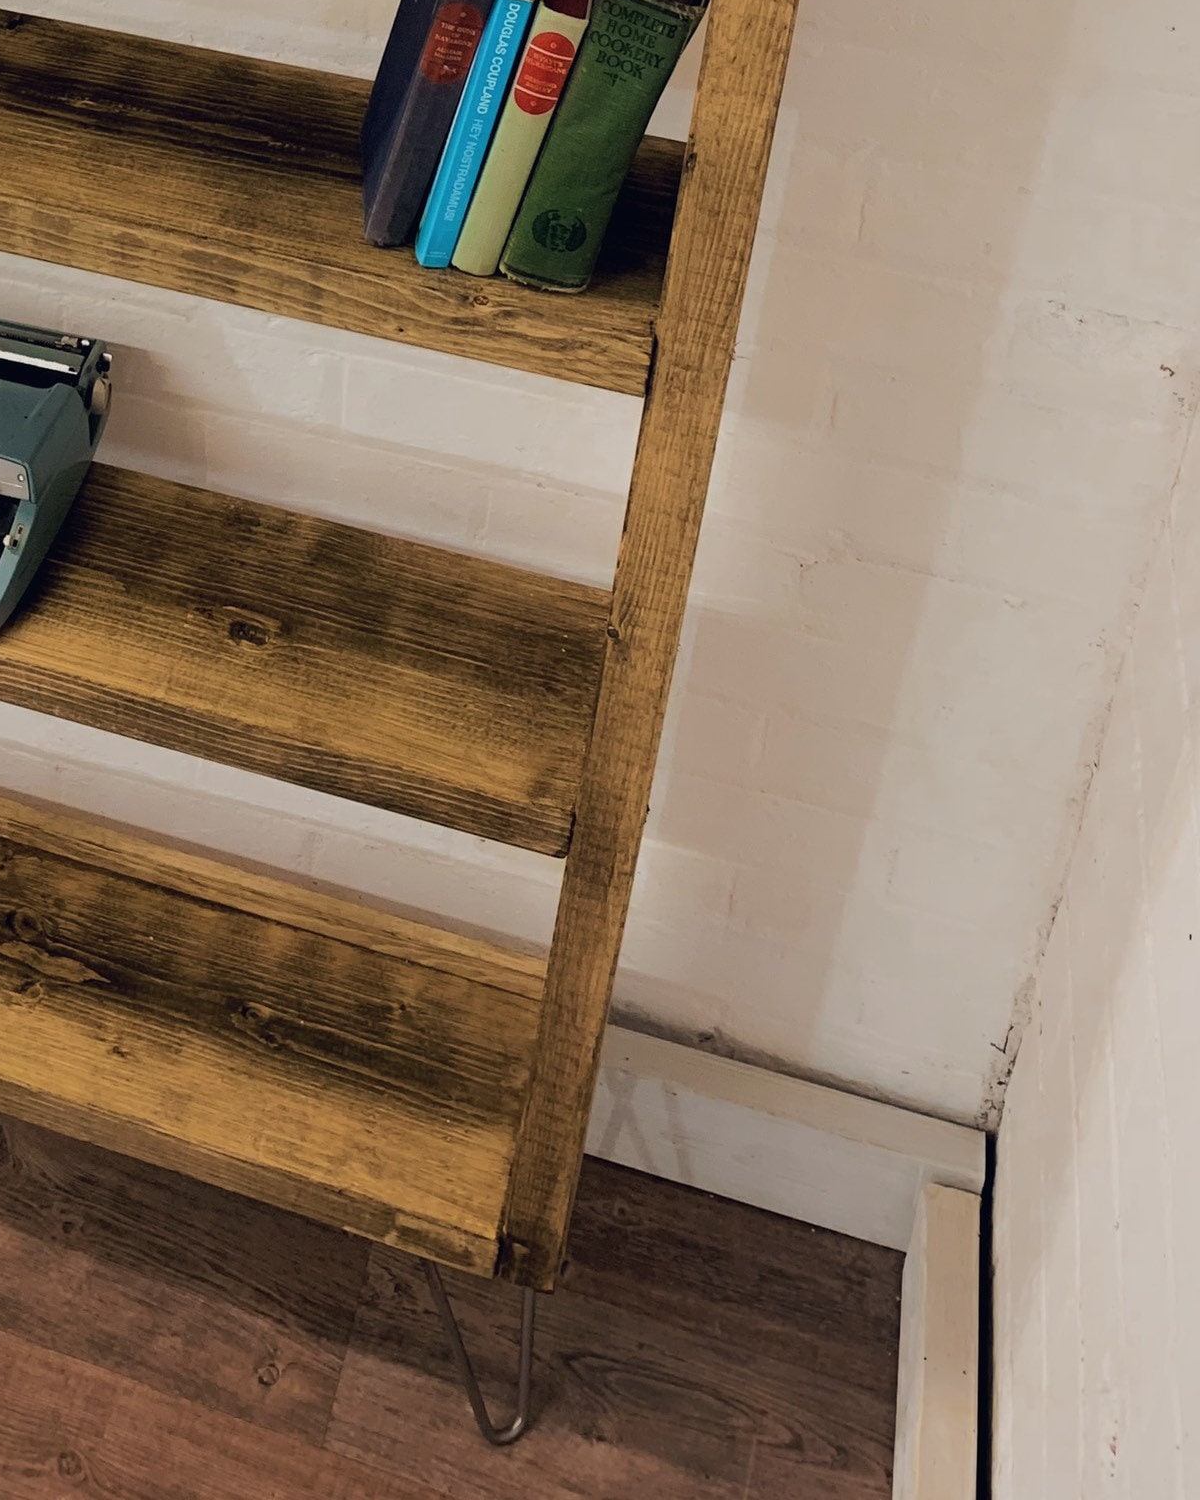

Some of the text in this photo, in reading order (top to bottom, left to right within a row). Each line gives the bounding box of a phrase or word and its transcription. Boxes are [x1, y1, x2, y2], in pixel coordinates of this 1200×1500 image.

[495, 2, 521, 56] DOUGLAS
[601, 0, 678, 39] COMPLETE
[606, 19, 657, 49] HOME
[590, 31, 665, 69] COOKERY
[595, 50, 646, 80] BOOK
[476, 56, 504, 115] COUPLAND
[469, 118, 484, 140] HEY
